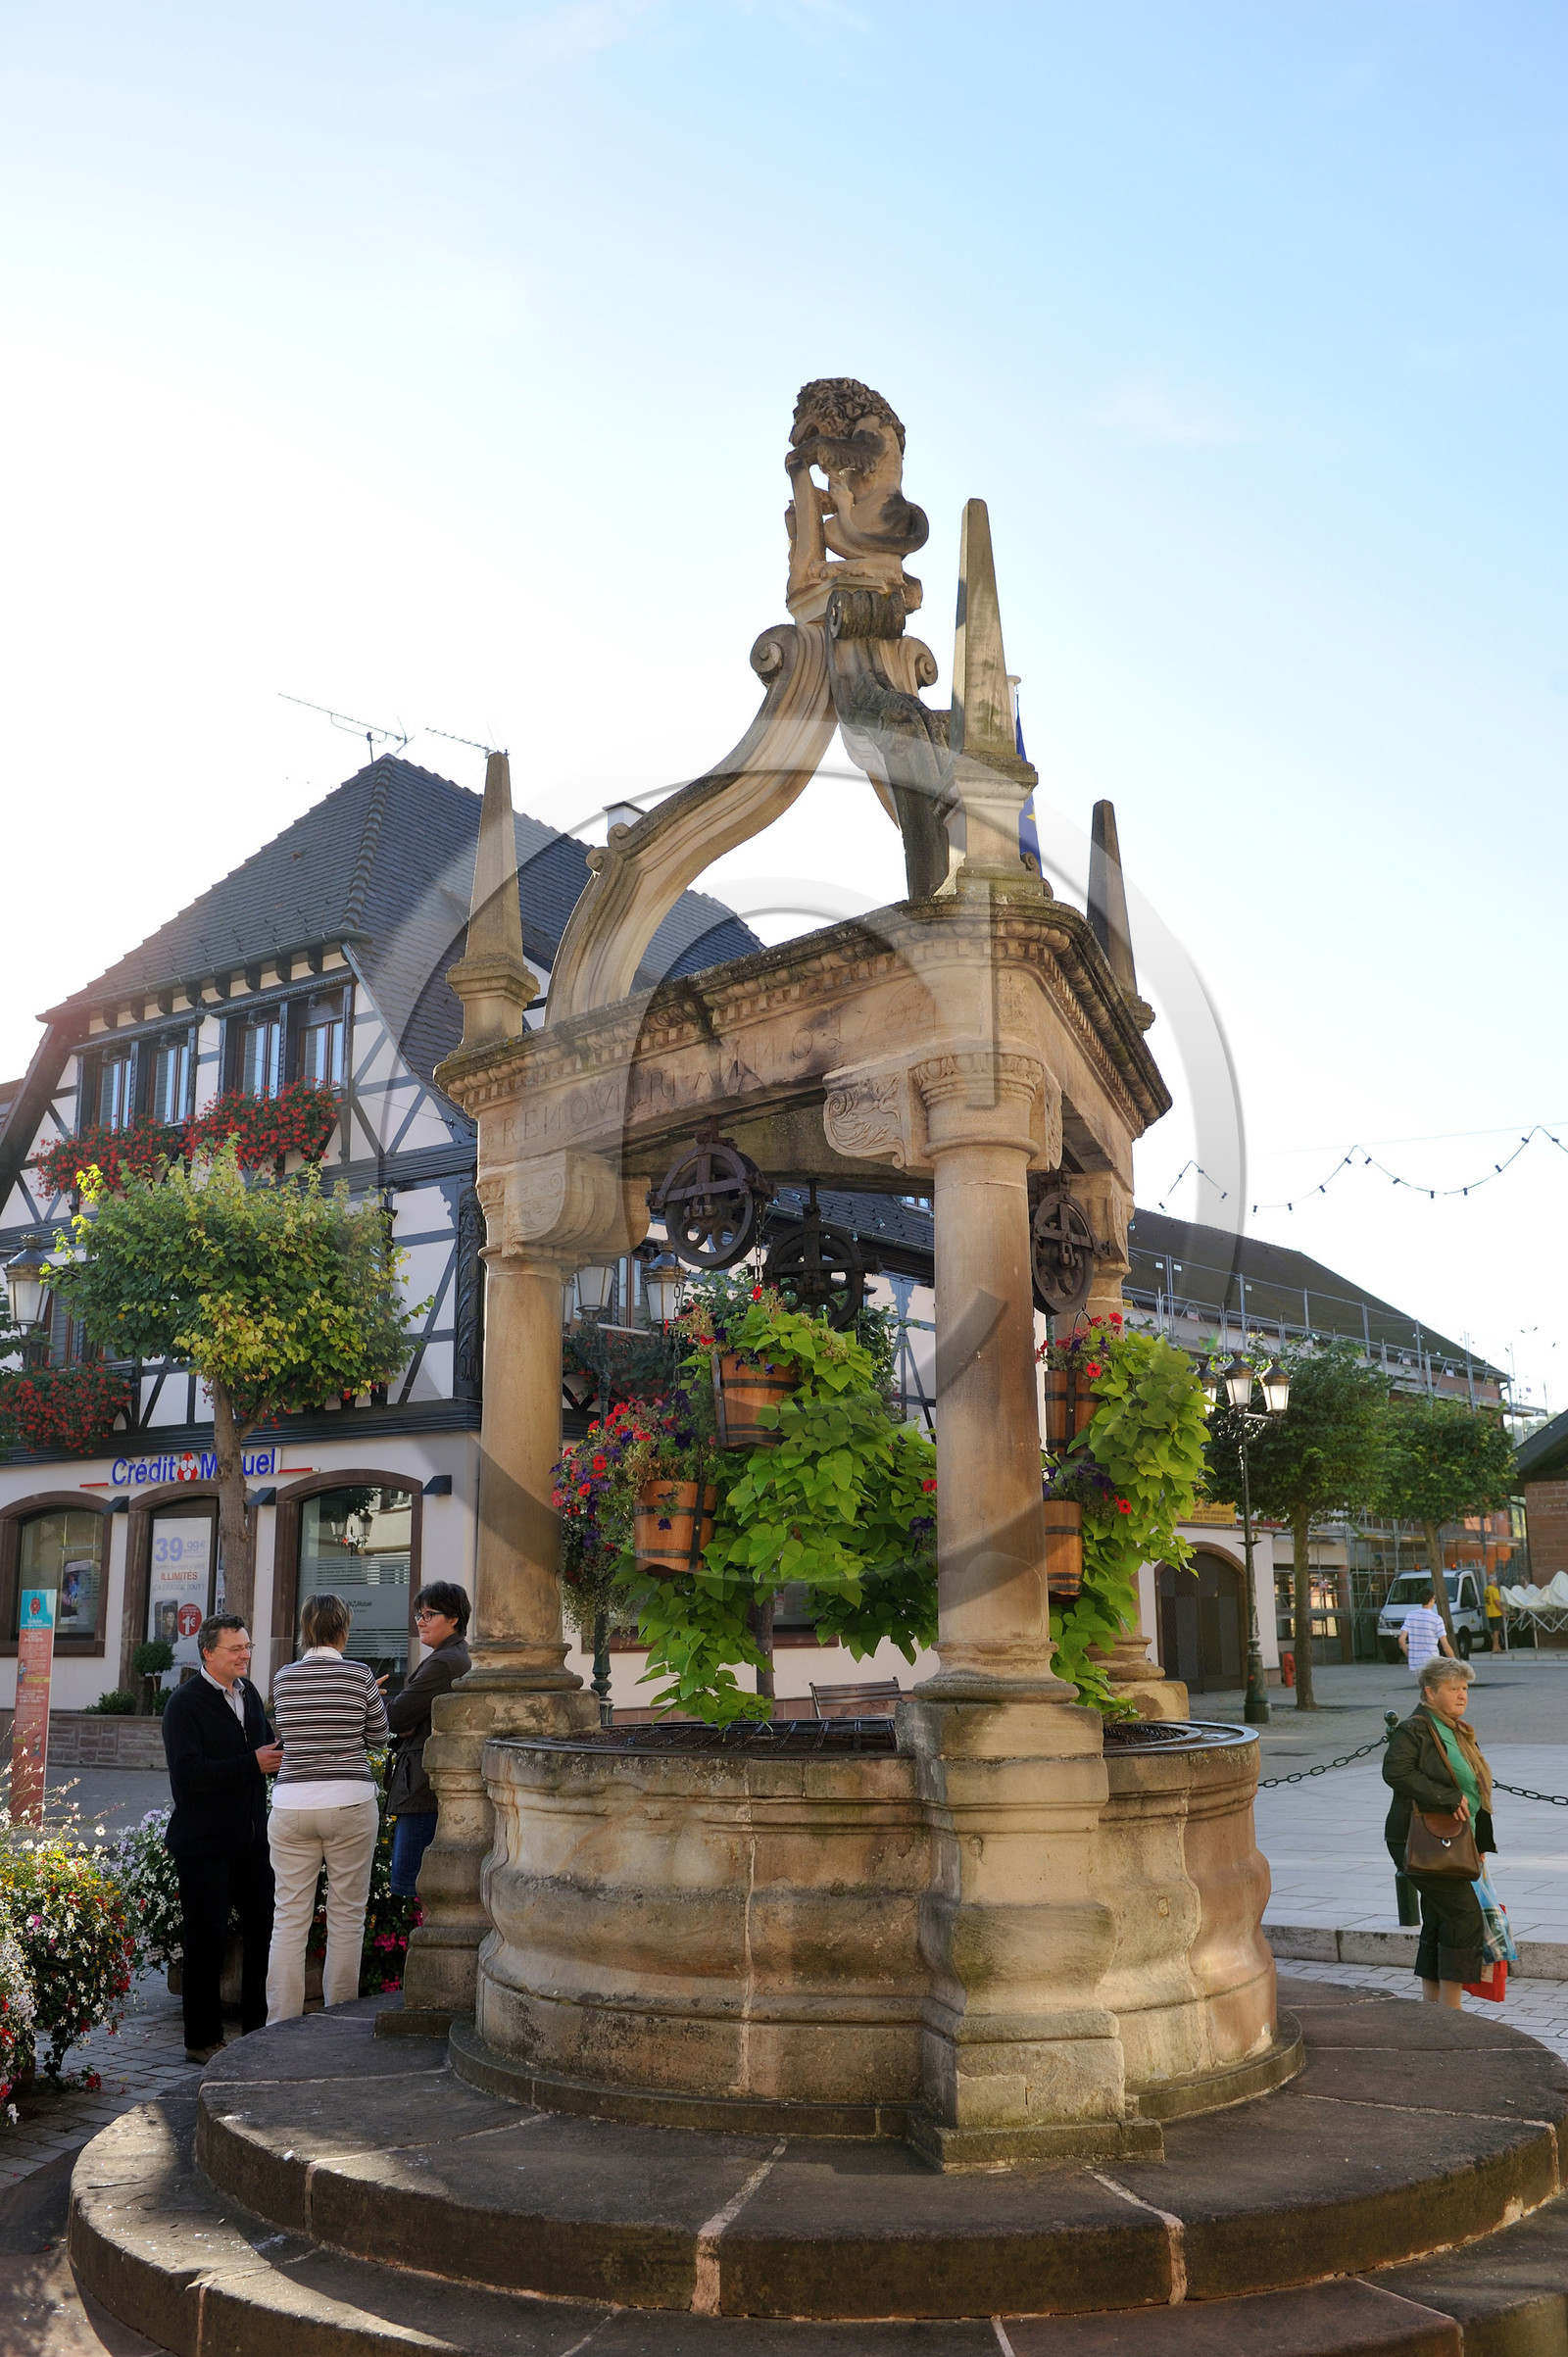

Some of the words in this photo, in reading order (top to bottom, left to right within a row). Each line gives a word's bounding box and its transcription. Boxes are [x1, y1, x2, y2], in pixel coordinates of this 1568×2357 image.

[112, 1456, 176, 1486] Crédit
[200, 1448, 276, 1480] Muel
[161, 1570, 198, 1581] ILLIMITÉS
